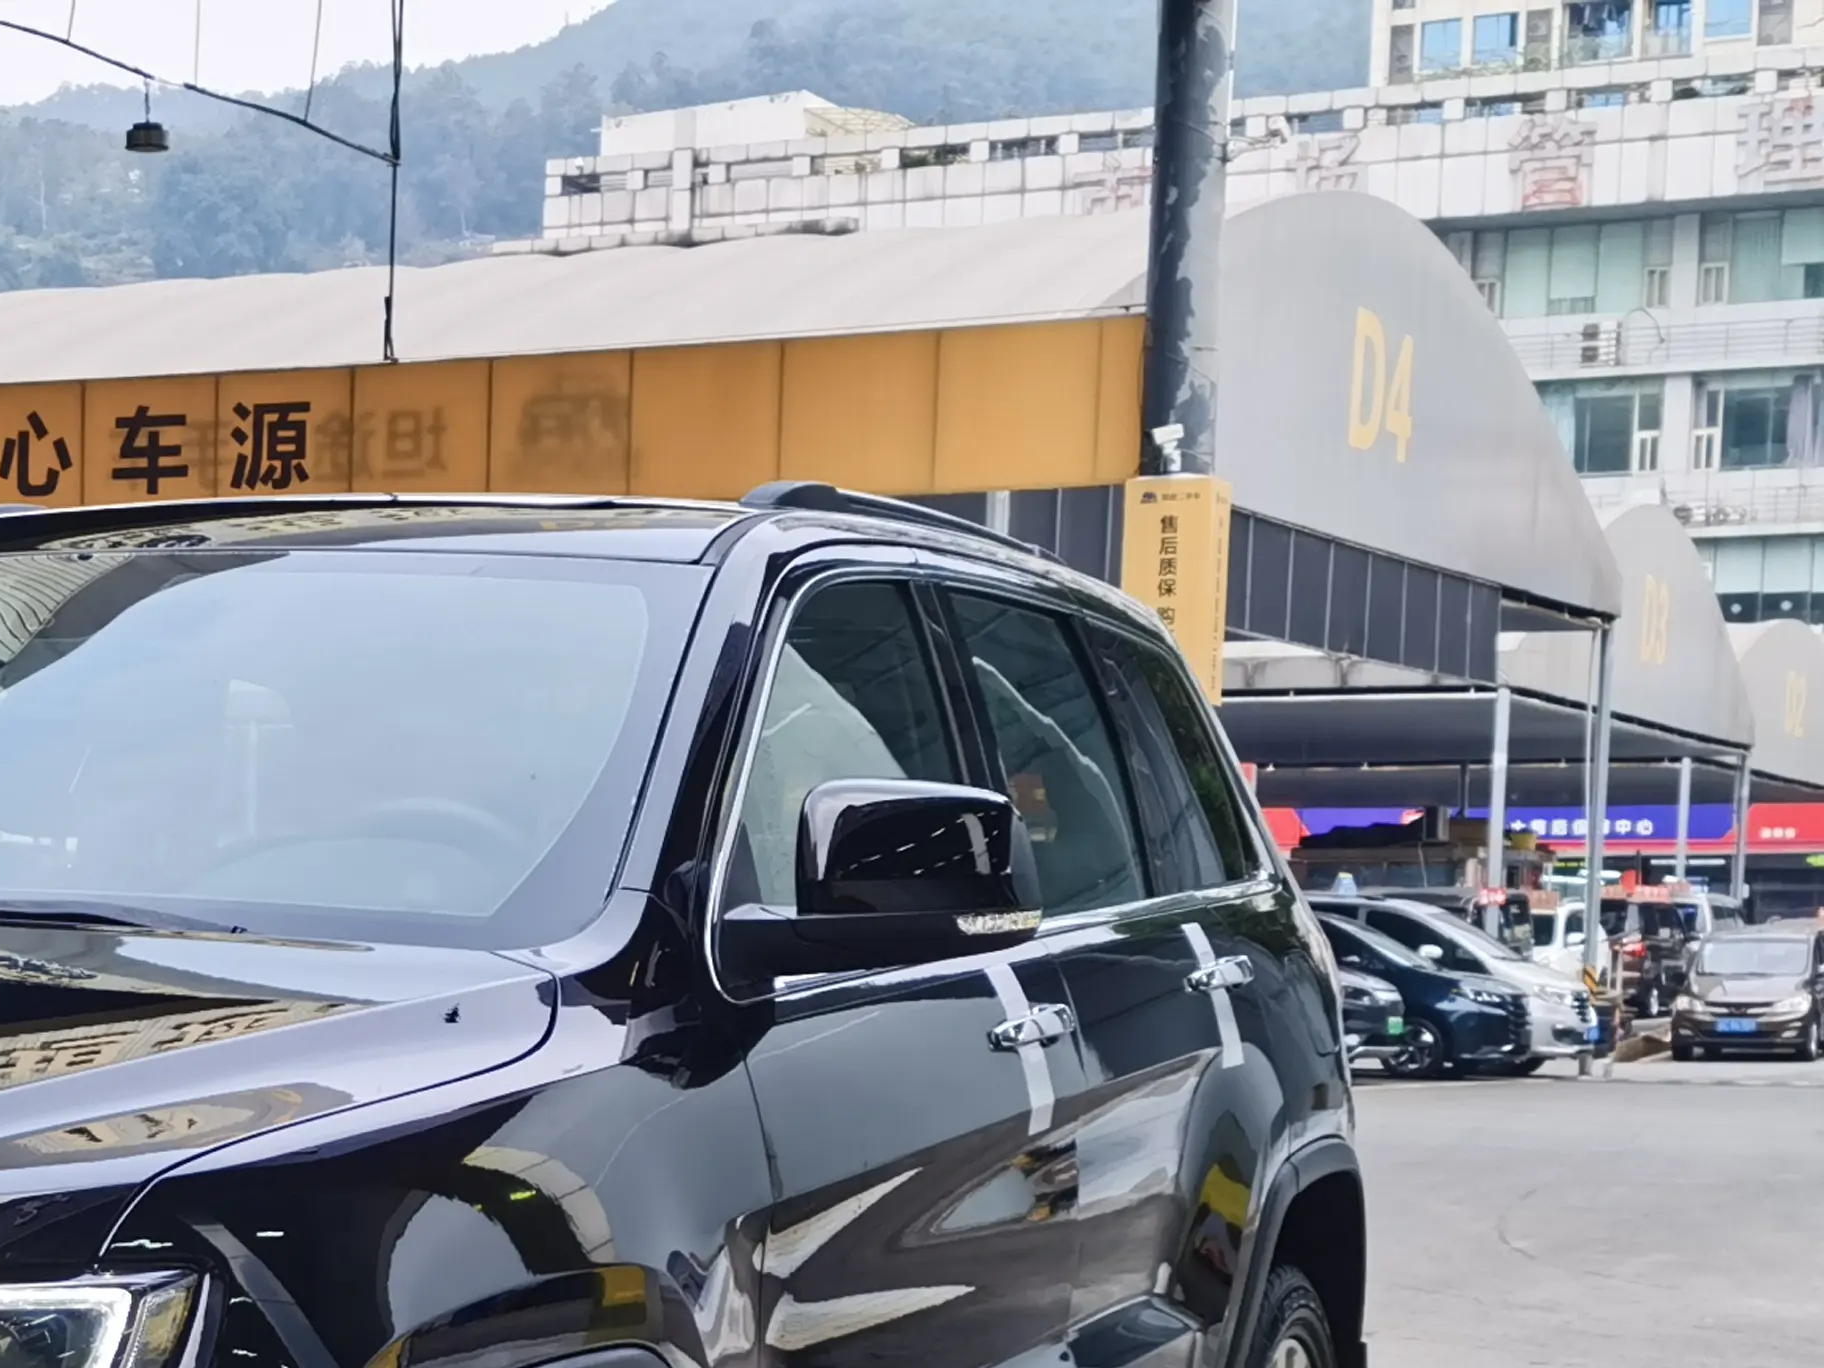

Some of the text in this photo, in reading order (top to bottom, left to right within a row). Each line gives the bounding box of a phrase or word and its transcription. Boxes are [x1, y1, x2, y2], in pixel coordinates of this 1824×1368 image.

[1347, 305, 1415, 465] D4
[1157, 514, 1179, 598] 售后质保
